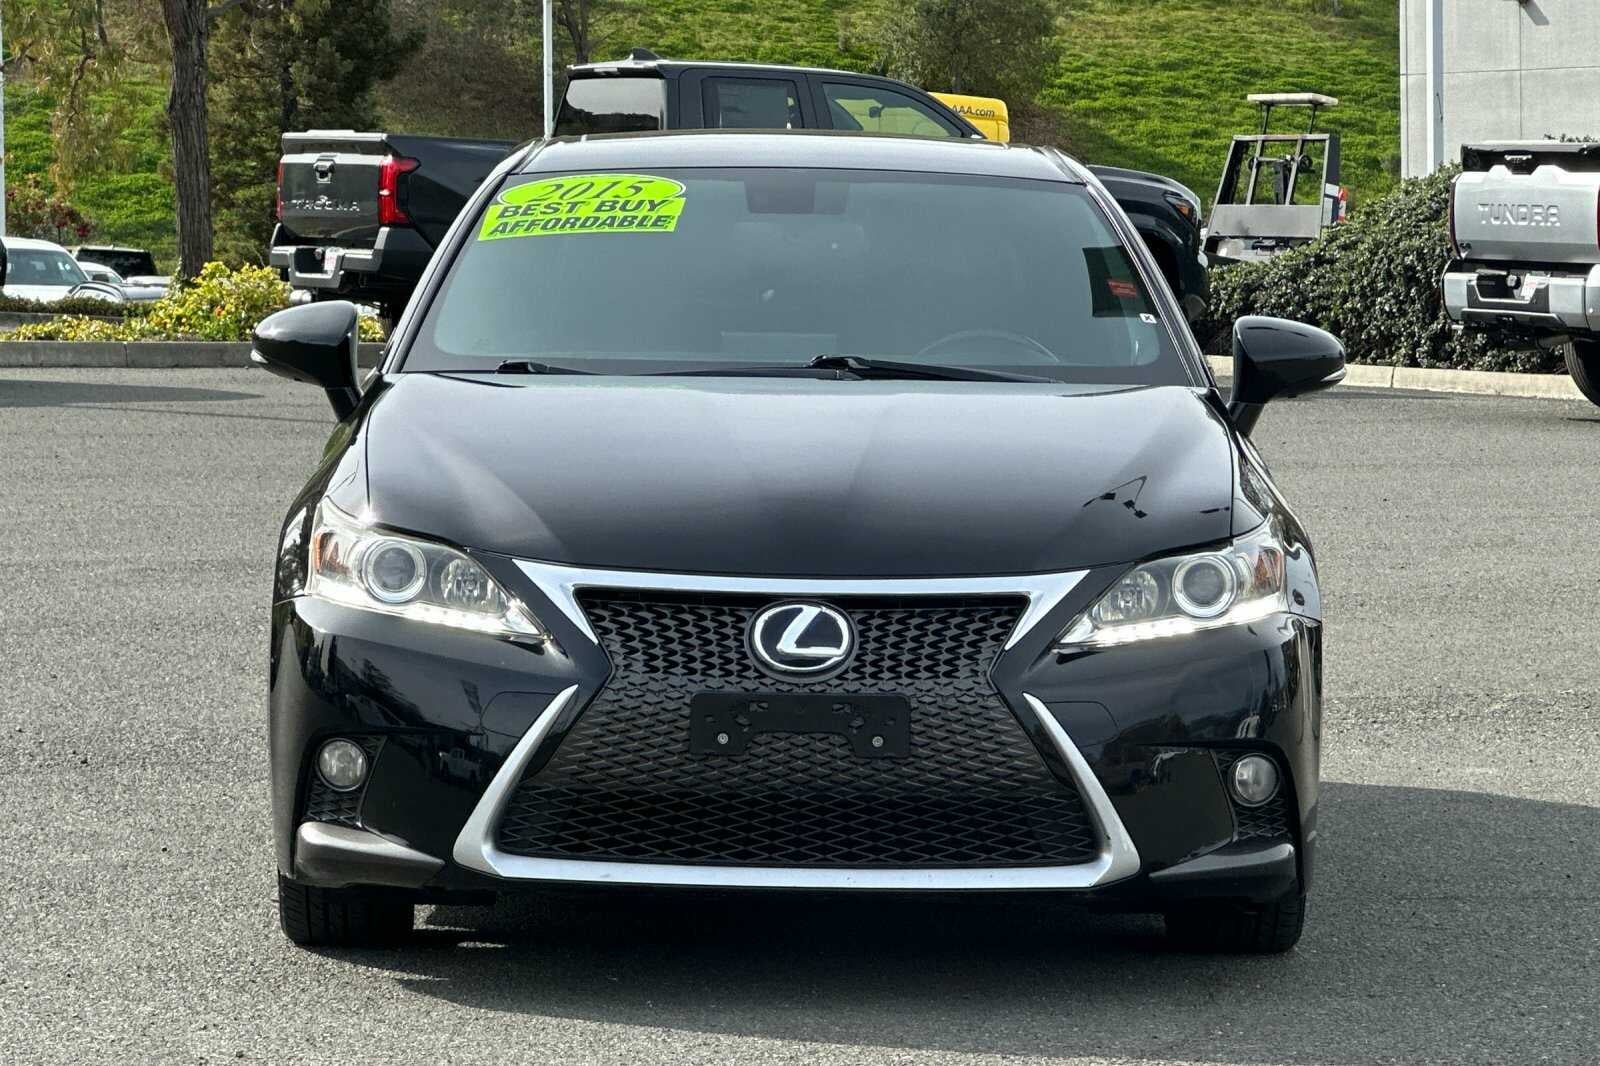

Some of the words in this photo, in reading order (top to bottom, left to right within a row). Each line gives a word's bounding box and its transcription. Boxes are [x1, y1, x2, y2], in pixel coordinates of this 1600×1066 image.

[531, 180, 655, 202] 2015
[497, 201, 587, 219] BEST
[594, 199, 670, 213] BUY
[1477, 203, 1561, 226] TUNDRA
[487, 215, 675, 235] AFFORDABLE
